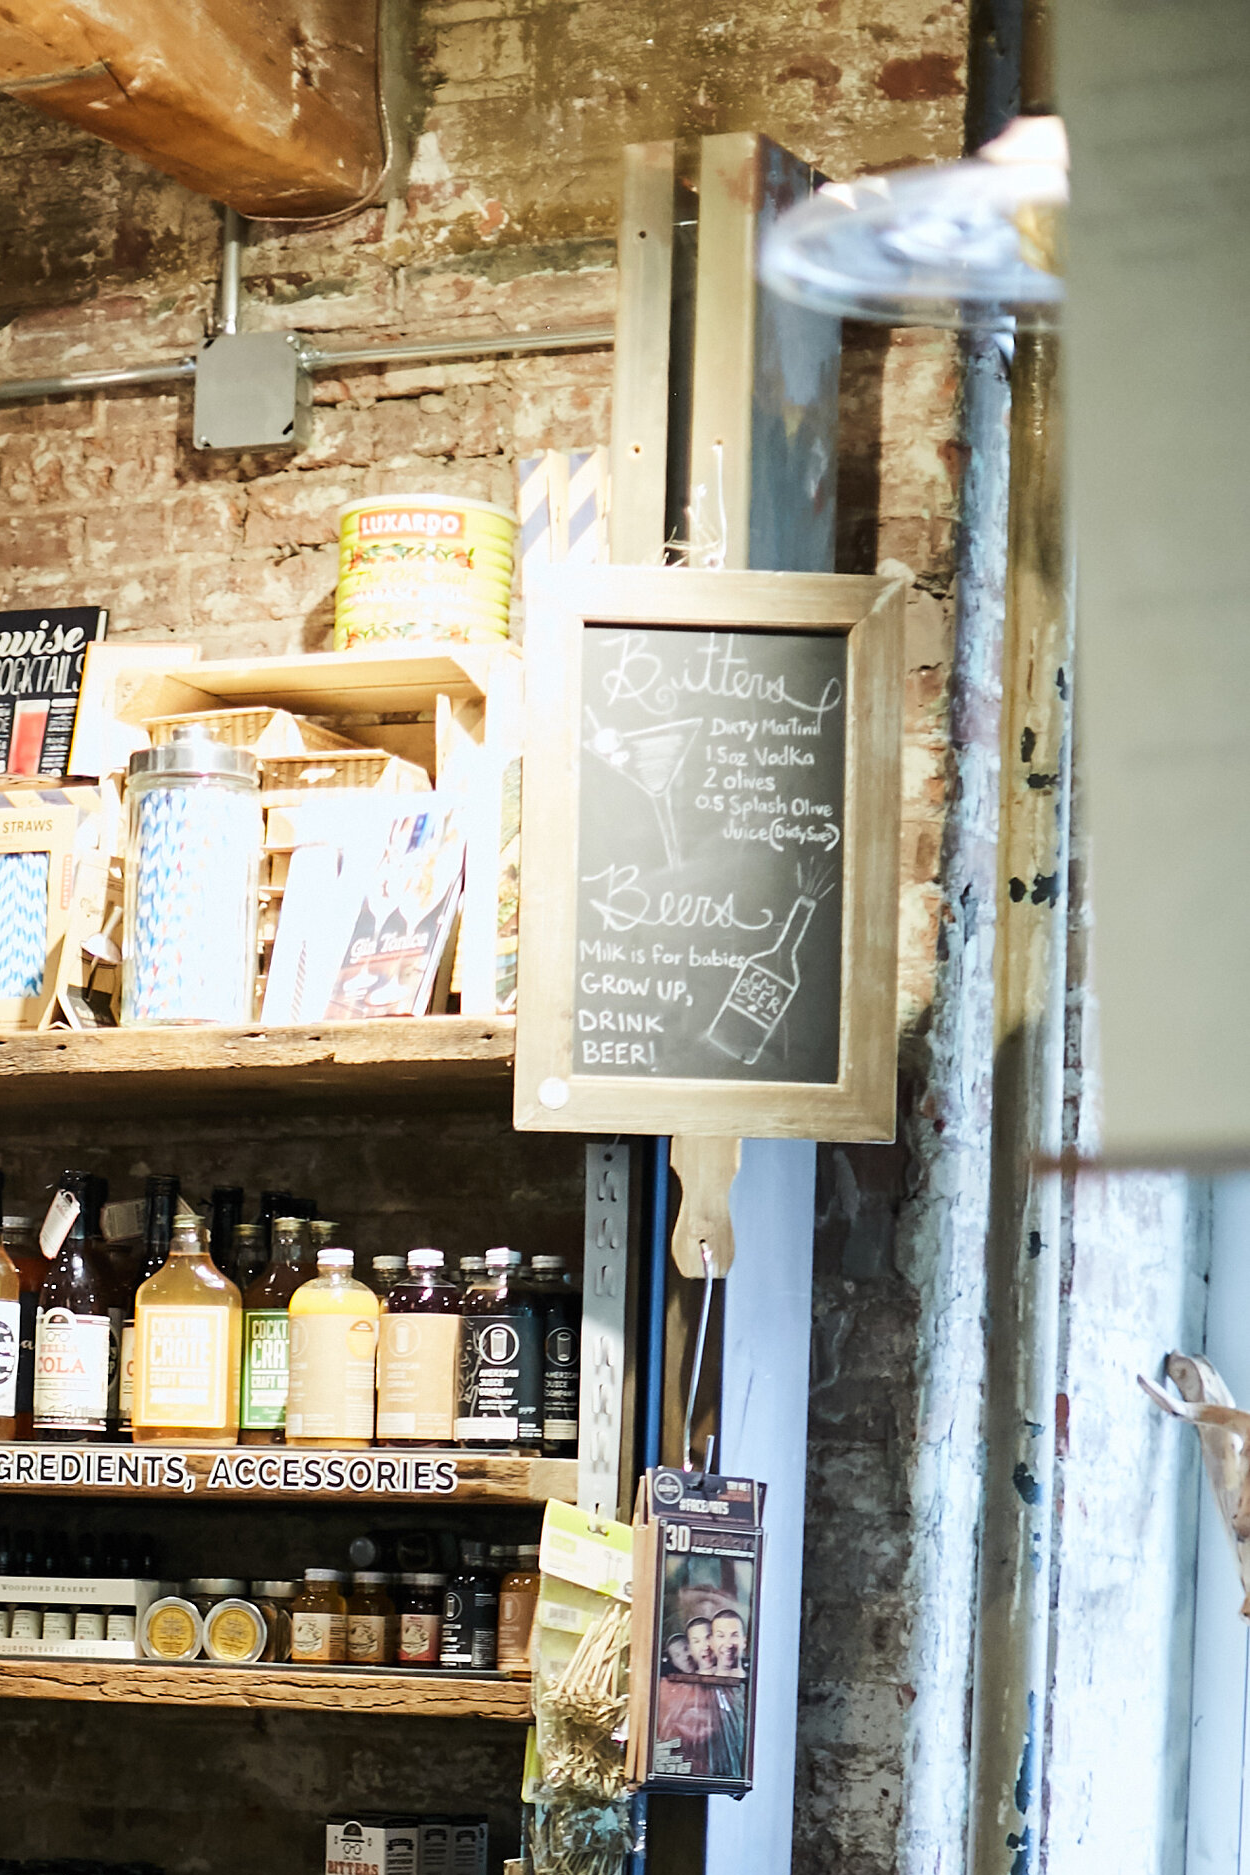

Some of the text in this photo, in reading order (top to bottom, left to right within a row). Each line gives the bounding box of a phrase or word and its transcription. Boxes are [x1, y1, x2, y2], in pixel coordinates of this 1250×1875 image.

[361, 512, 460, 537] LUXARDO
[599, 632, 842, 716] Bitters
[703, 767, 776, 792] 2 olives
[694, 794, 834, 822] 0.5 Splash Olive
[2, 819, 54, 835] STRAWS
[581, 863, 774, 932] Beers
[579, 939, 627, 963] Milk
[630, 945, 646, 964] is
[652, 943, 684, 965] for
[580, 971, 694, 1007] GROW UP,
[735, 978, 782, 1015] BEER
[578, 1009, 665, 1033] DRINK
[582, 1039, 658, 1072] BEER!
[252, 1319, 289, 1340] COCKT
[478, 1369, 520, 1378] AMERICAN
[207, 1454, 459, 1494] ACCESSORIES
[665, 1524, 691, 1553] 3D
[1, 1583, 97, 1594] WOODFORD RESERVE
[36, 1644, 74, 1655] BARREL
